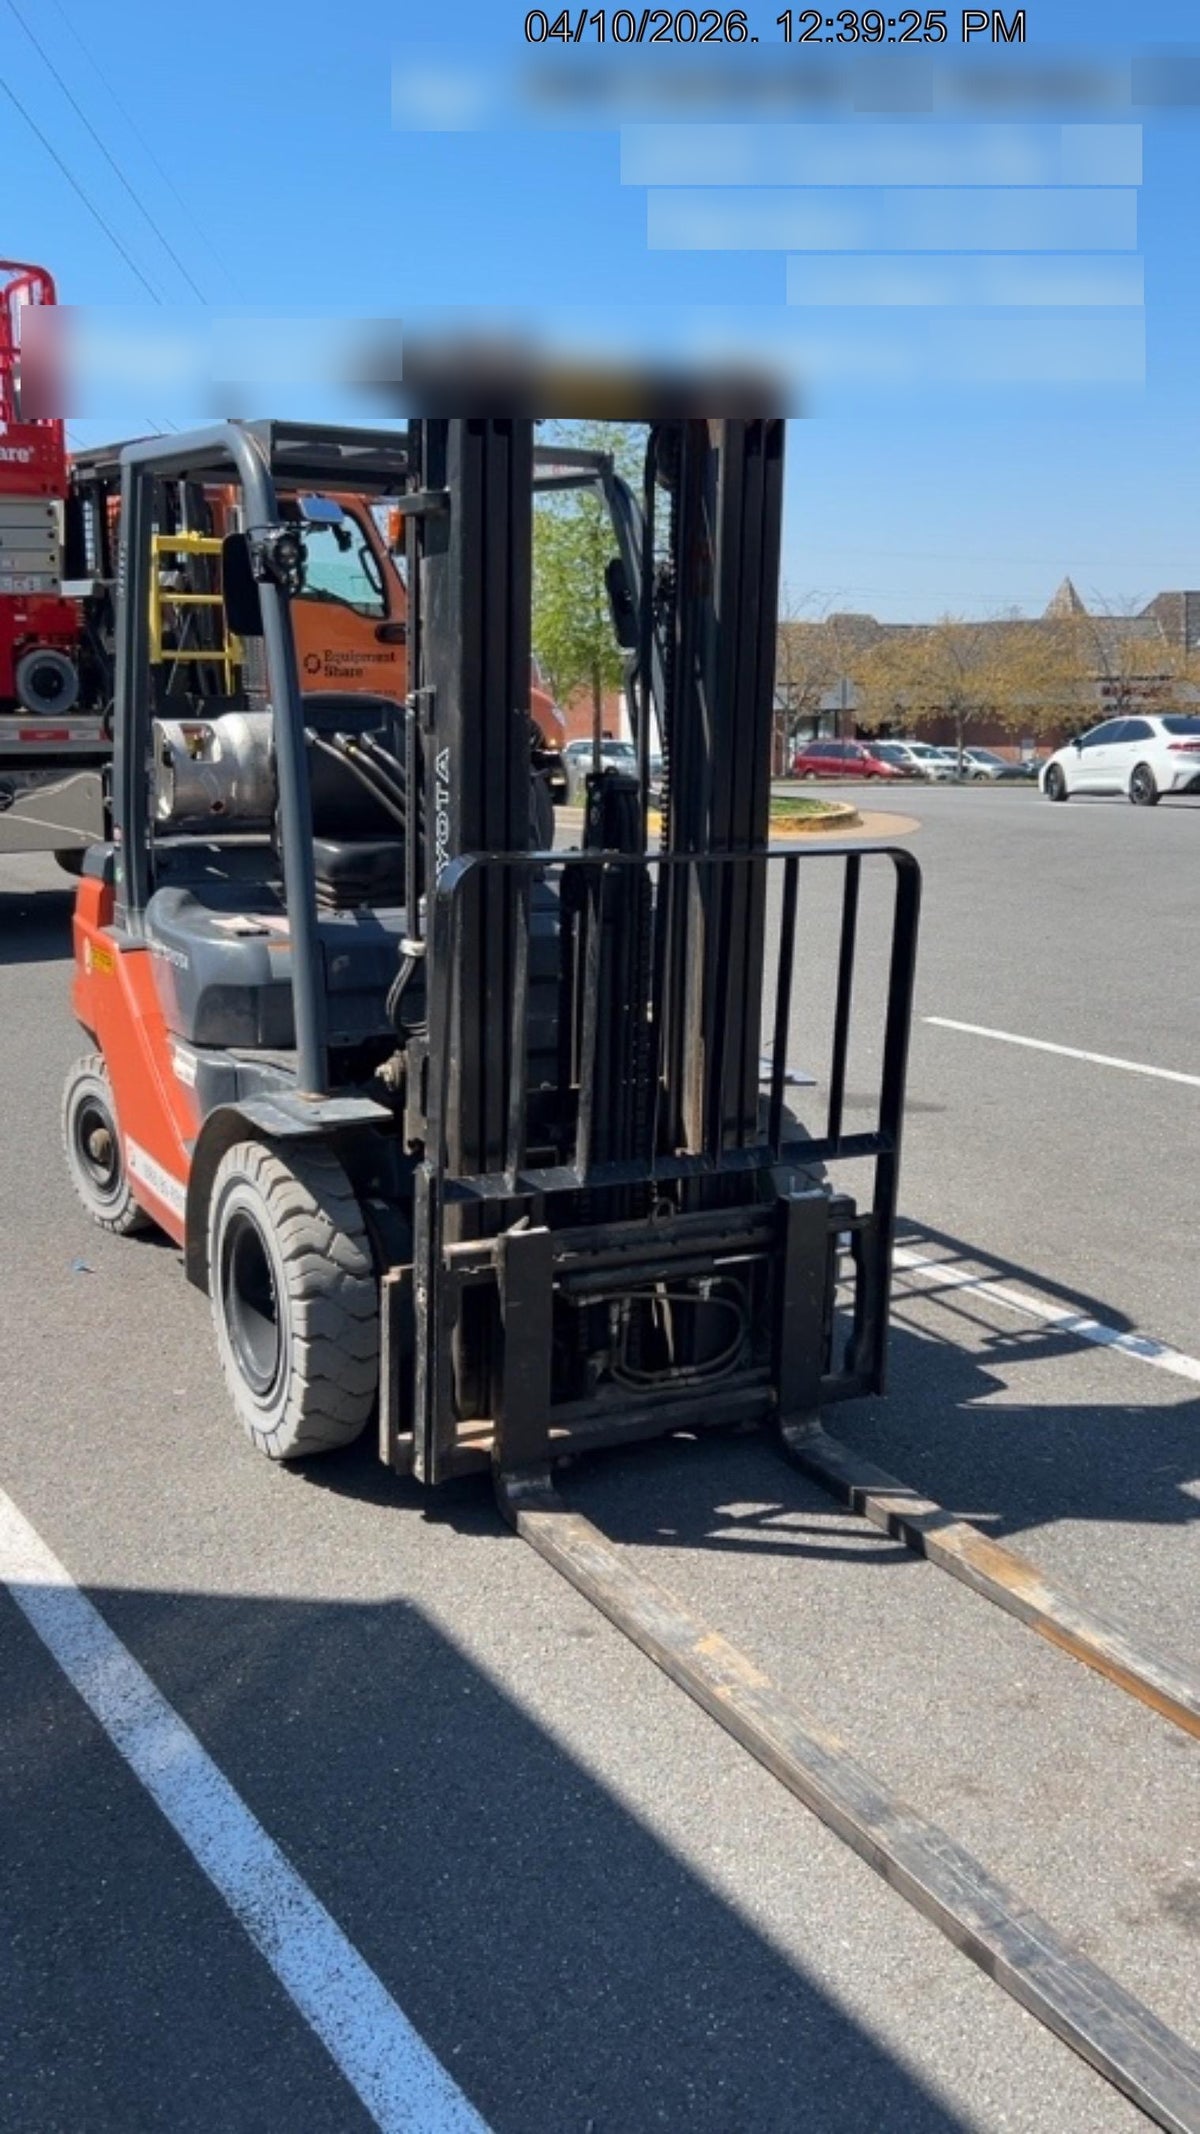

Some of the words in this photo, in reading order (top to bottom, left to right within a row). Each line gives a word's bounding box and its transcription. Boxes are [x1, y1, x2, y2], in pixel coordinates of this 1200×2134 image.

[0, 447, 30, 463] are
[324, 649, 396, 665] Equipment
[324, 665, 363, 677] Share
[436, 747, 449, 889] YOTA
